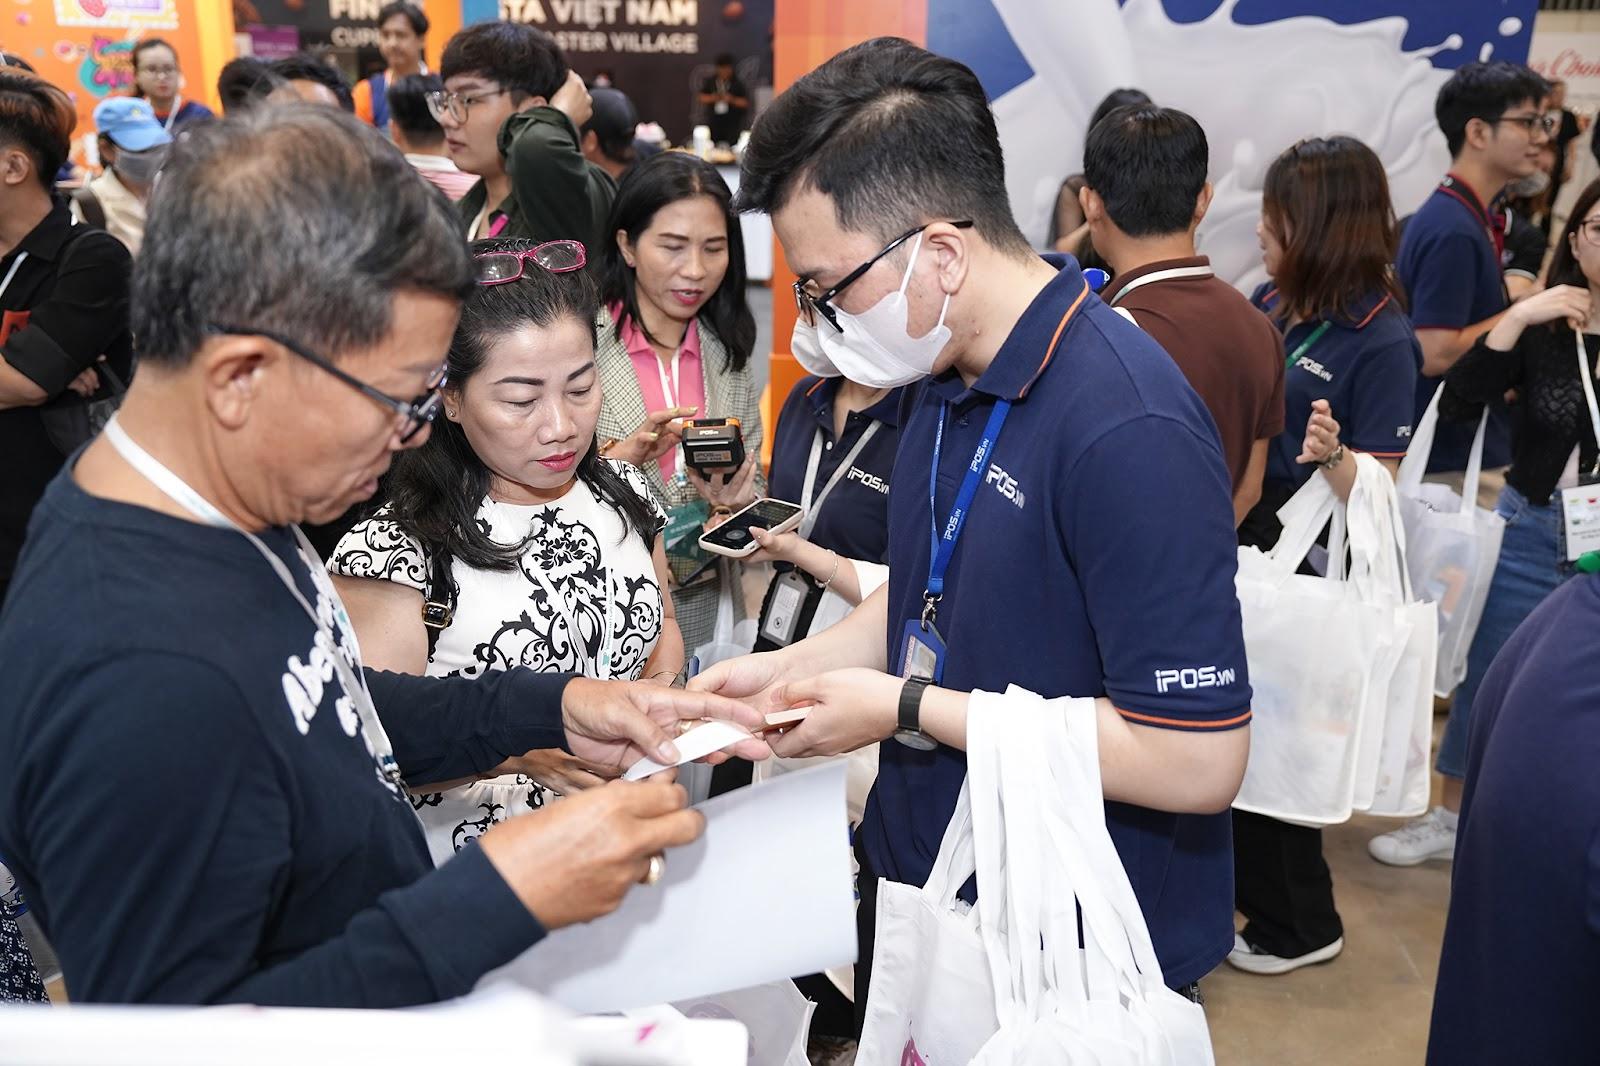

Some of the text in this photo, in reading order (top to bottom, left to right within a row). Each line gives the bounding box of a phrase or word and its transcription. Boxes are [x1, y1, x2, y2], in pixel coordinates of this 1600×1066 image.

[329, 0, 388, 20] FIN
[625, 0, 698, 26] NAM
[609, 31, 699, 54] VILLAGE
[1154, 665, 1236, 693] iPOS.VN
